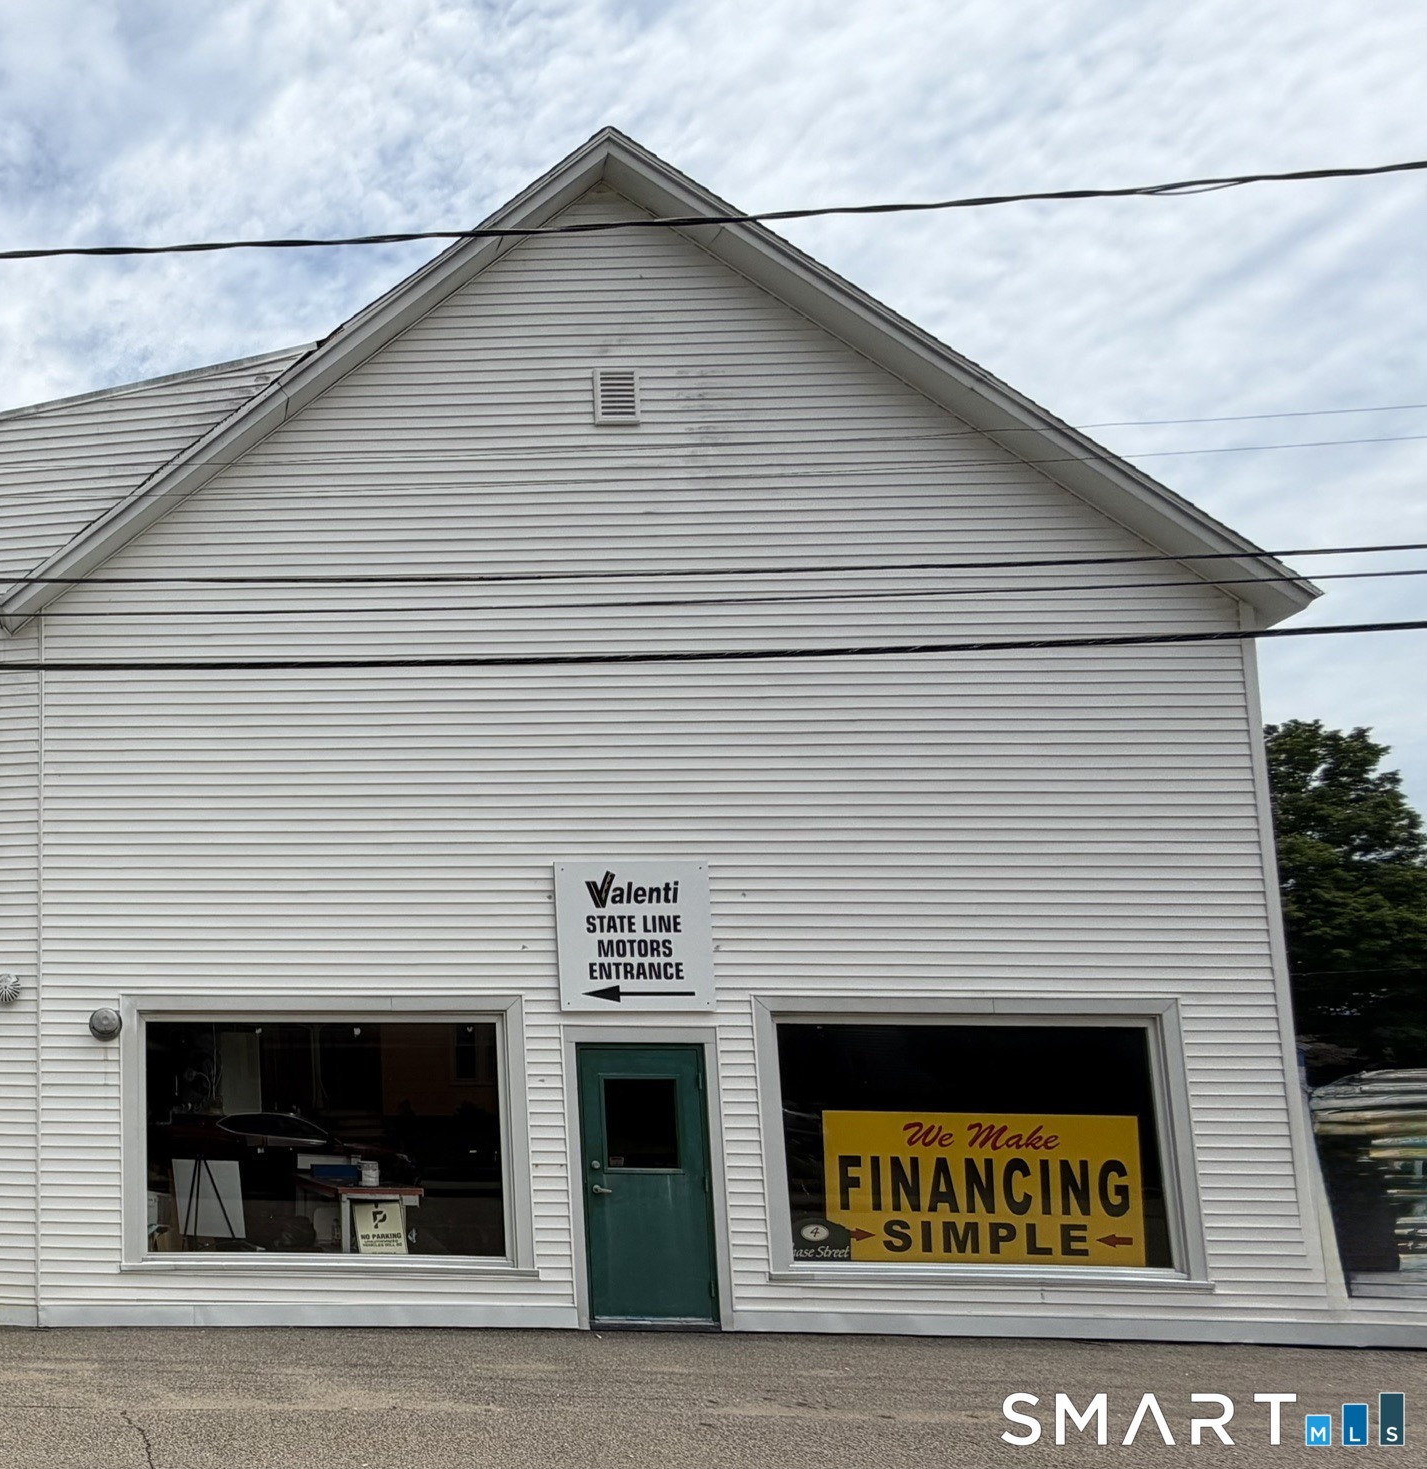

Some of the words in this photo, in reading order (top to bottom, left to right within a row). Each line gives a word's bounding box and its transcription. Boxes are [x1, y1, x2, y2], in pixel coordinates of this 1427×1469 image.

[585, 870, 679, 908] Valenti
[586, 915, 636, 933] STATE
[642, 915, 682, 933] LINE
[597, 939, 672, 958] MOTORS
[589, 962, 684, 980] ENTRANCE
[902, 1121, 954, 1148] We
[966, 1122, 1060, 1151] Make
[838, 1154, 1130, 1217] FINANCING
[372, 1232, 401, 1240] PARKING
[810, 1226, 820, 1237] 4
[882, 1219, 1090, 1257] SIMPLE
[815, 1245, 850, 1258] Street
